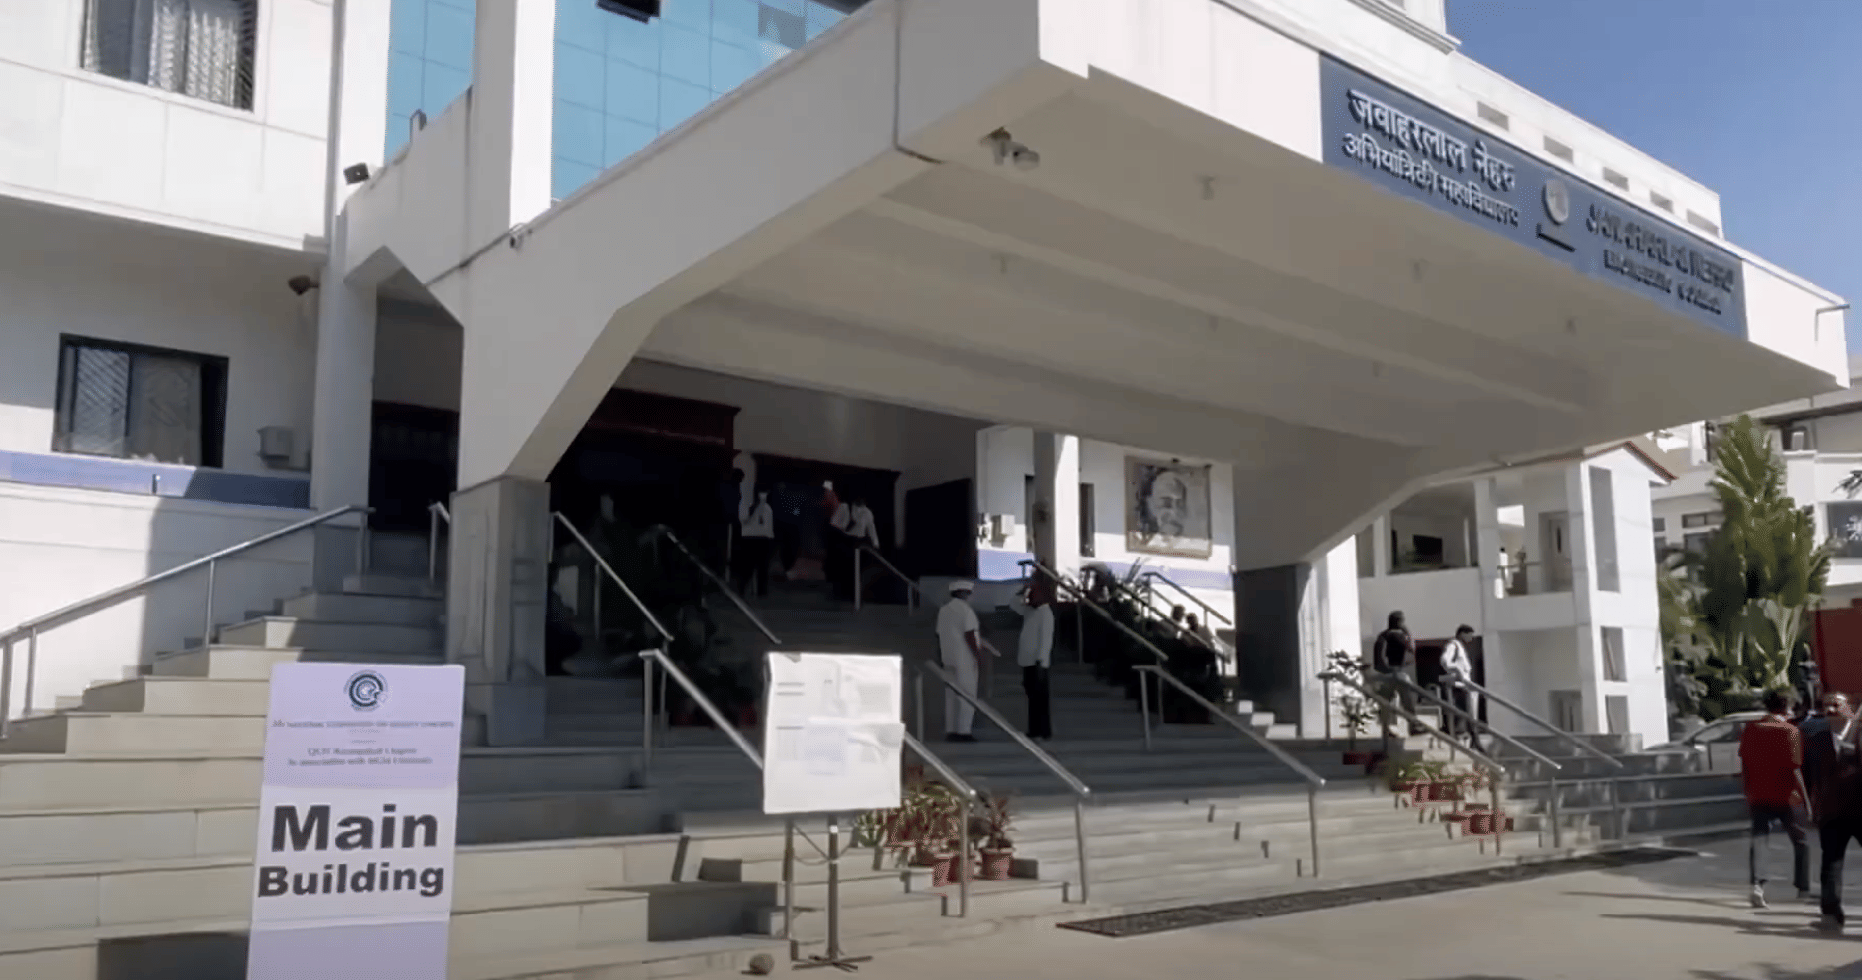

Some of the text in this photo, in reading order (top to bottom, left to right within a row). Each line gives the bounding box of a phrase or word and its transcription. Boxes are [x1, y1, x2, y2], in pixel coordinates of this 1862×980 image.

[1346, 89, 1468, 174] जवाहरलाल
[271, 804, 439, 852] Main
[258, 862, 444, 898] Building
